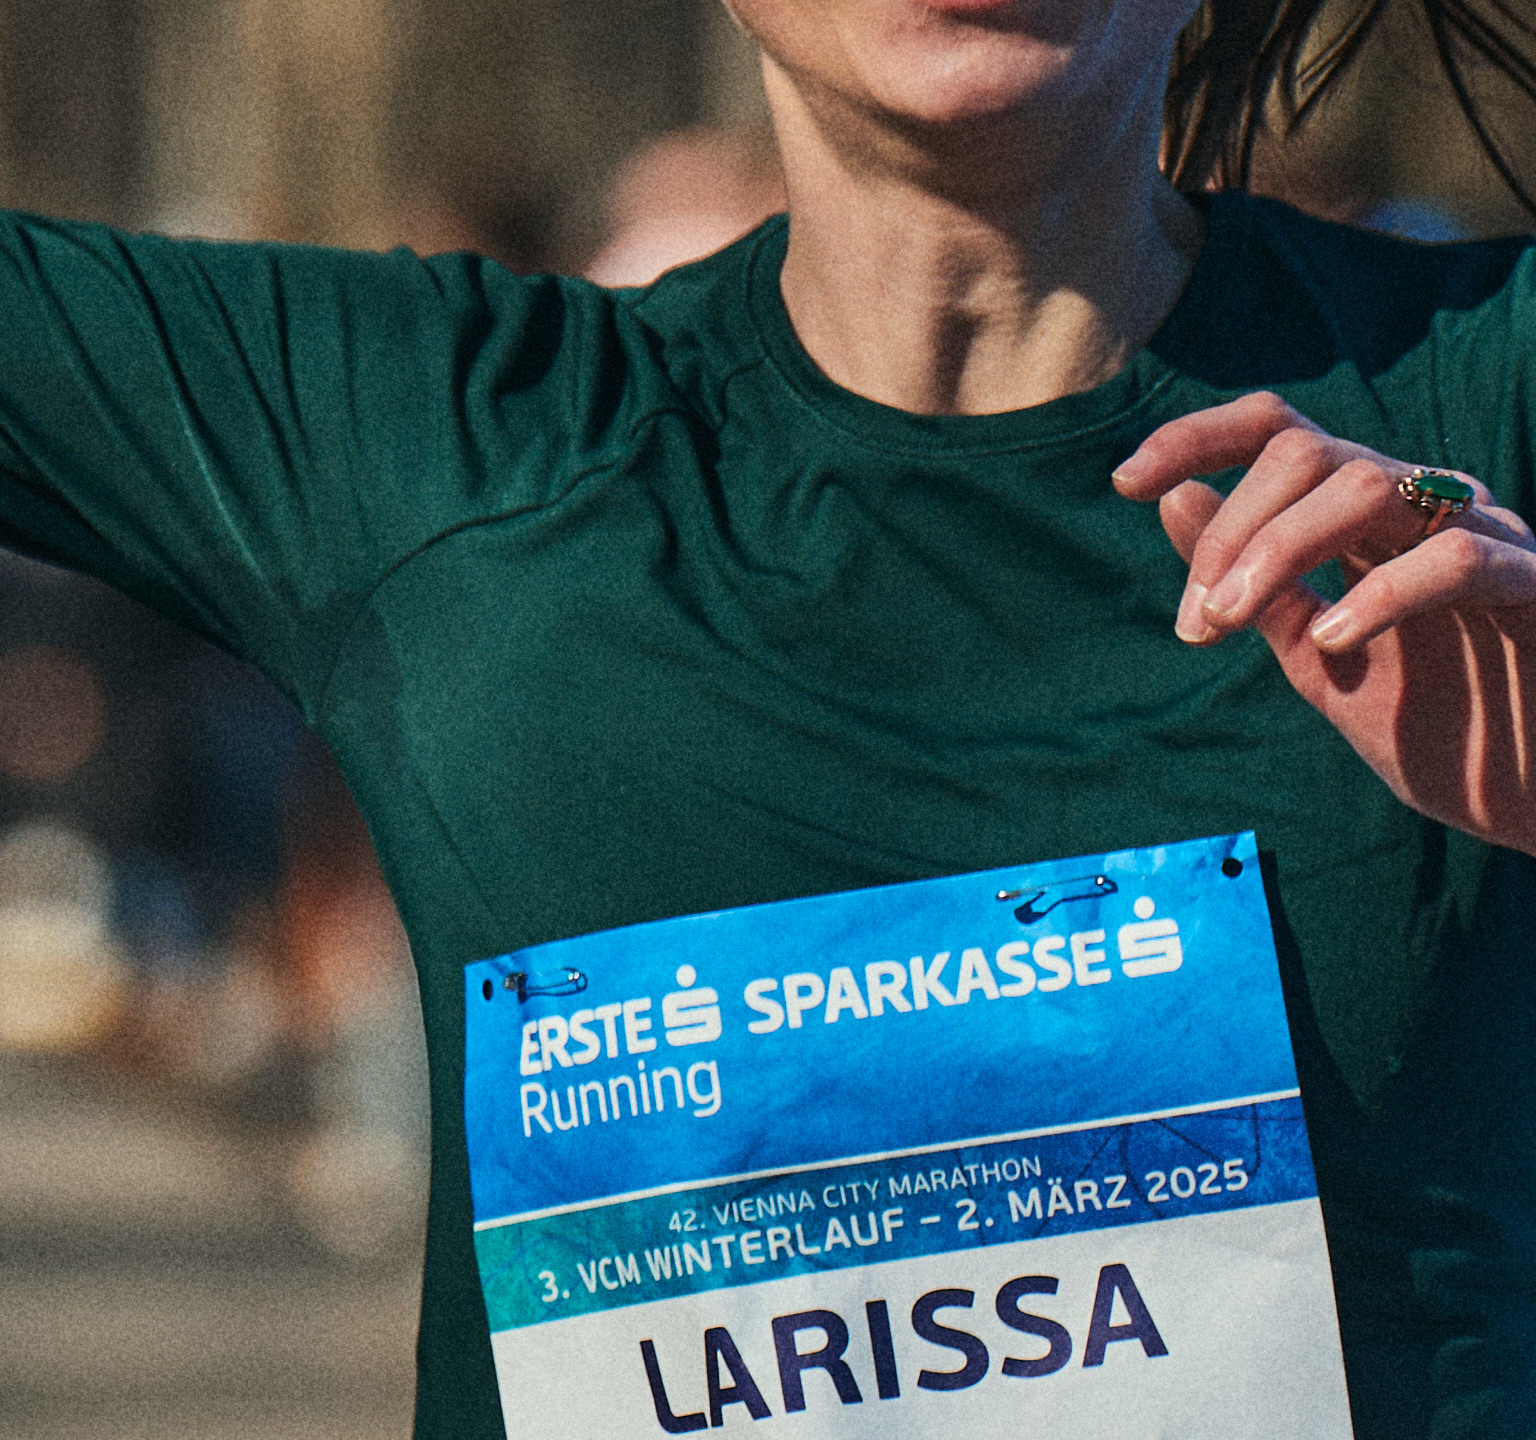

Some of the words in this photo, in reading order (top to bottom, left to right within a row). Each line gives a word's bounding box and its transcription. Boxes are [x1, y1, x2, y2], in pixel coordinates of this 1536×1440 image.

[519, 996, 658, 1077] ERSTE
[743, 928, 1112, 1035] SPARKASSE
[519, 1059, 723, 1138] Running
[537, 1269, 571, 1304] 3.
[576, 1252, 643, 1295] VCM
[643, 1206, 905, 1283] WINTERLAUF
[954, 1198, 995, 1232] 2.
[1006, 1176, 1132, 1224] MÄRZ
[1144, 1158, 1250, 1203] 2025
[668, 1208, 707, 1234] 42.
[712, 1189, 816, 1227] VIENNA
[821, 1176, 881, 1209] CITY
[888, 1155, 1043, 1199] MARATHON
[639, 1262, 1169, 1435] LARISSA
